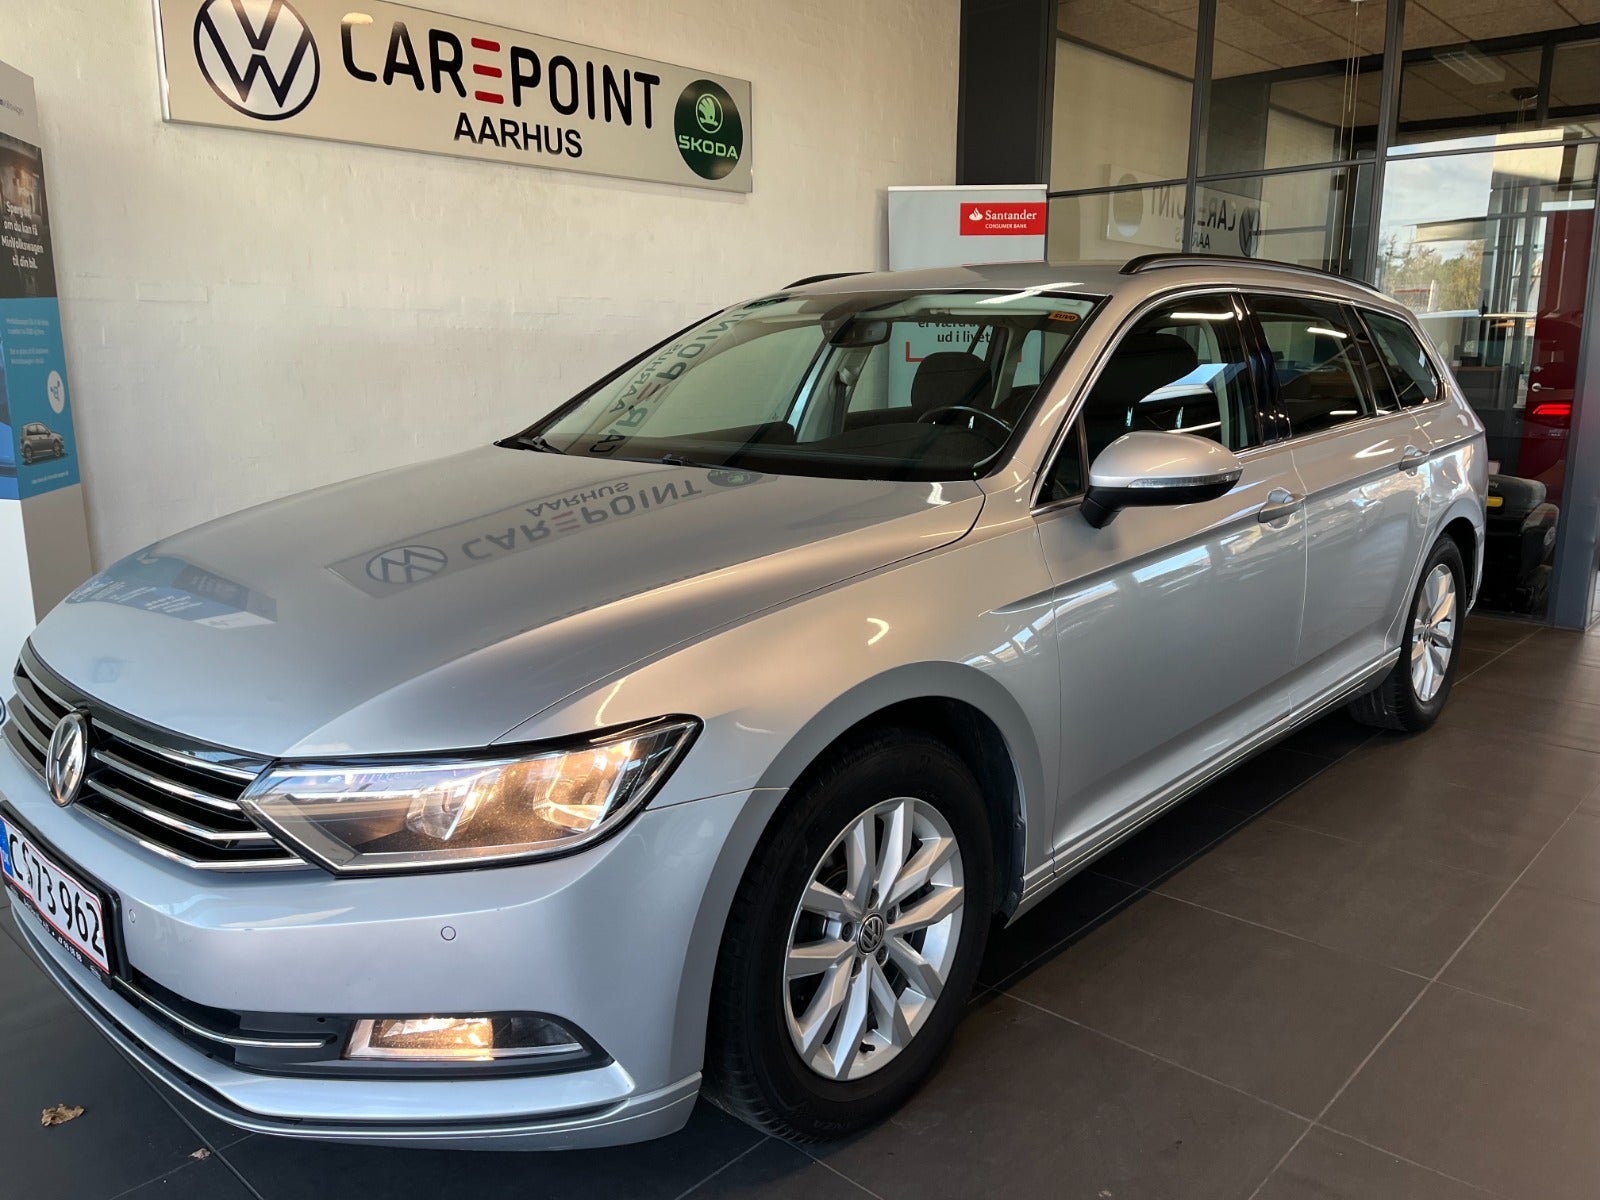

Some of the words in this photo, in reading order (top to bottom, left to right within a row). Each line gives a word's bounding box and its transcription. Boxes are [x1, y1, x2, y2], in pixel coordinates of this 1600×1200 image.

[453, 112, 583, 159] AARHUS
[984, 208, 1038, 221] Santander
[937, 330, 953, 342] ud
[956, 330, 960, 342] i
